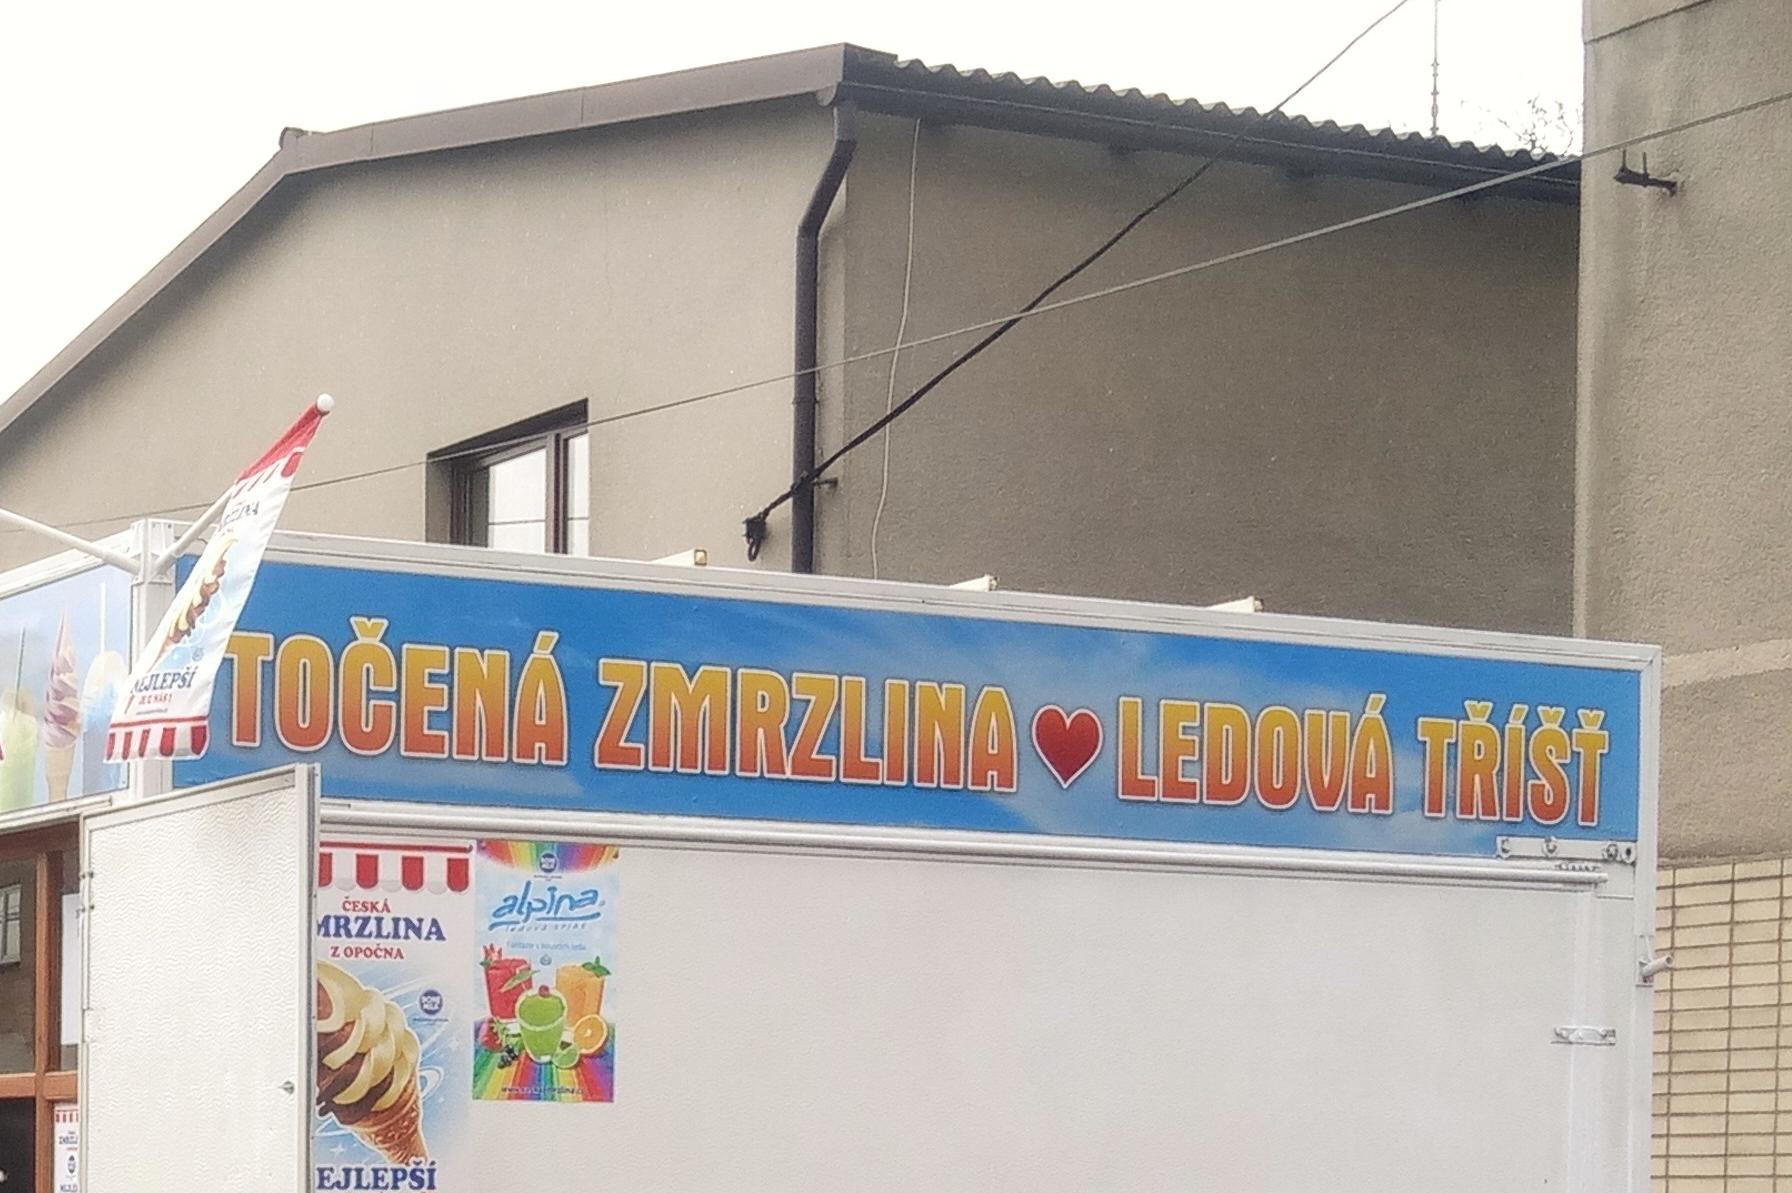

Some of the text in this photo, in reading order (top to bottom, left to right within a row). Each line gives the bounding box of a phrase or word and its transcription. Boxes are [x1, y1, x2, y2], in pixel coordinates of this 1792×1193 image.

[223, 616, 1610, 827] TOČENÁ ZMRZLINA LEDOVÁ TŘÍŠŤ
[341, 896, 391, 913] ČESKÁ
[492, 880, 599, 923] alpina
[330, 943, 404, 959] Z OPOČNA
[316, 1160, 437, 1190] EJLEPŠÍ
